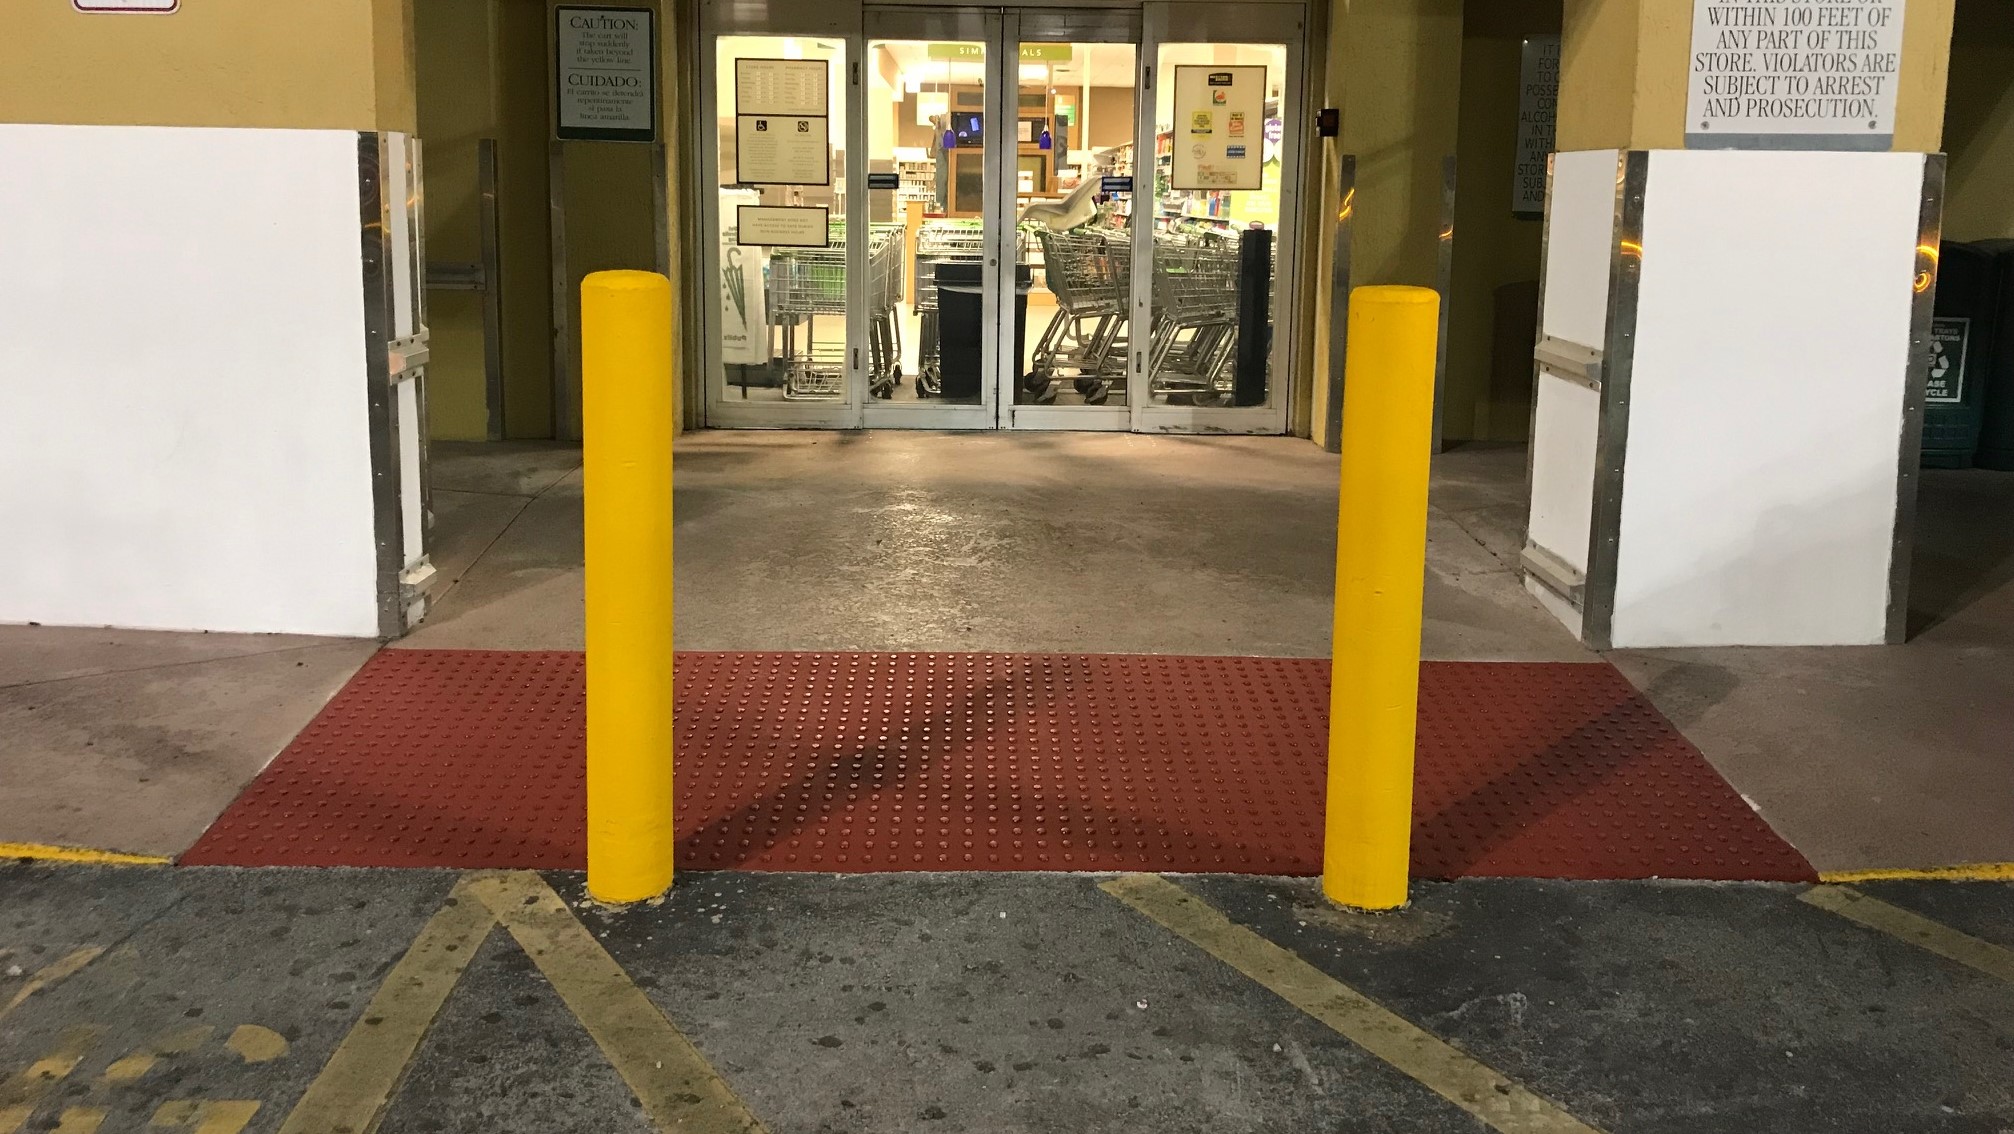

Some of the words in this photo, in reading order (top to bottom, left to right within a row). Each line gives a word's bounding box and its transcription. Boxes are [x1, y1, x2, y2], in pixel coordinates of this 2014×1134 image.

[570, 16, 638, 30] CAUTION:
[1708, 7, 1776, 27] WITHIN
[1783, 7, 1812, 27] 100
[1817, 7, 1863, 27] FEET
[1868, 7, 1892, 27] OF
[1716, 30, 1752, 50] ANY
[1756, 30, 1803, 50] PART
[1807, 30, 1831, 50] OF
[1836, 30, 1878, 50] THIS
[1695, 53, 1756, 73] STORE.
[1763, 53, 1857, 73] VIOLATORS
[1861, 53, 1896, 73] ARE
[568, 73, 641, 88] CUIDADO:
[1703, 75, 1780, 98] SUBJECT
[1784, 75, 1809, 95] TO
[1813, 75, 1885, 95] ARREST
[1702, 98, 1741, 118] AND
[1746, 98, 1878, 118] PROSECUTION.
[1529, 151, 1546, 162] AN
[1522, 190, 1544, 202] AND
